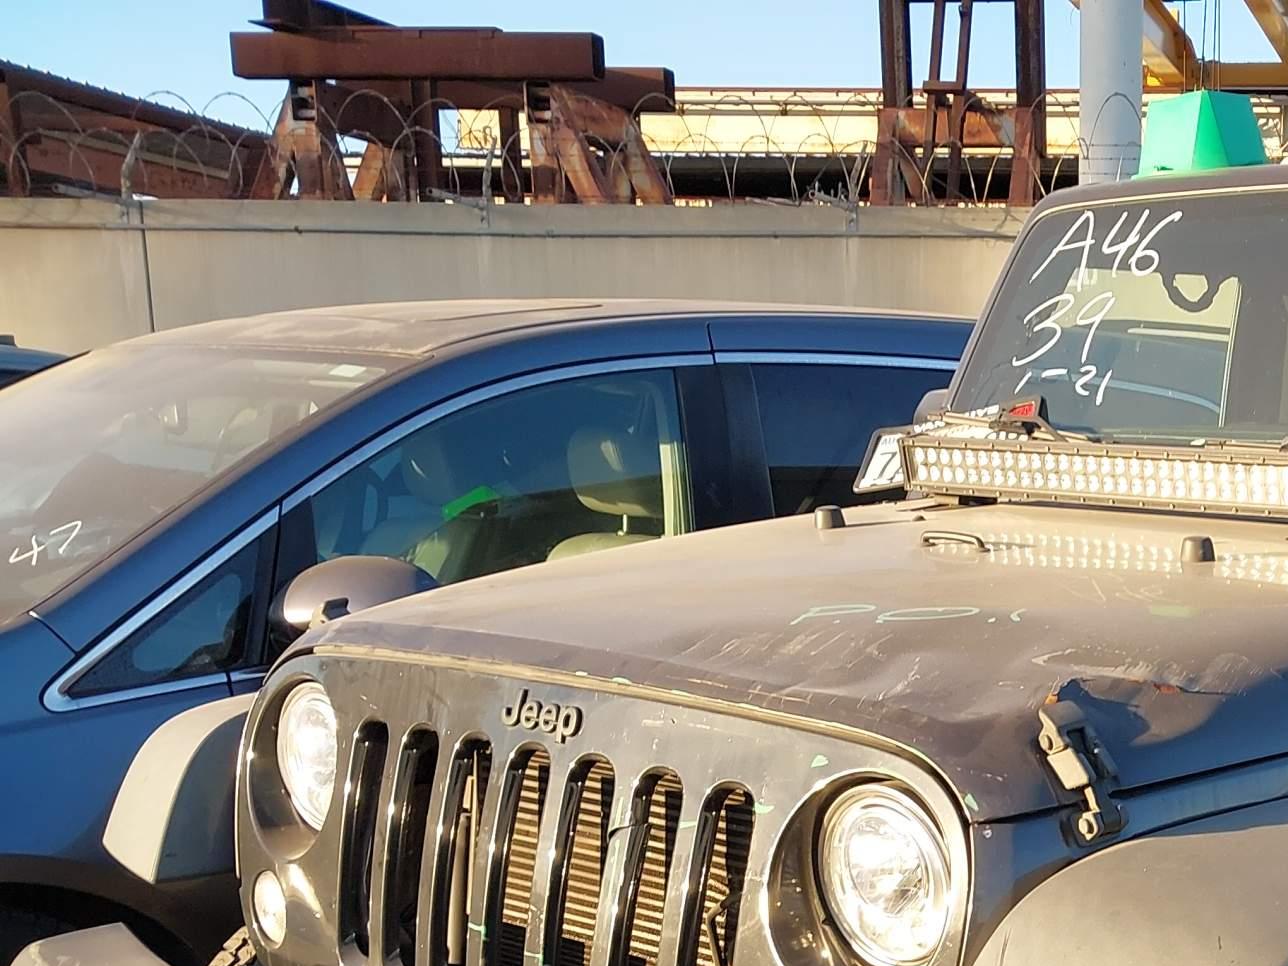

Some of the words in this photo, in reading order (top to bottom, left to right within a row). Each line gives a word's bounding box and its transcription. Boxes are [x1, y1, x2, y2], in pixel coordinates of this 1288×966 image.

[1029, 209, 1183, 292] A46
[1012, 291, 1117, 367] 39
[9, 520, 82, 566] 47
[502, 688, 584, 744] Jeep
